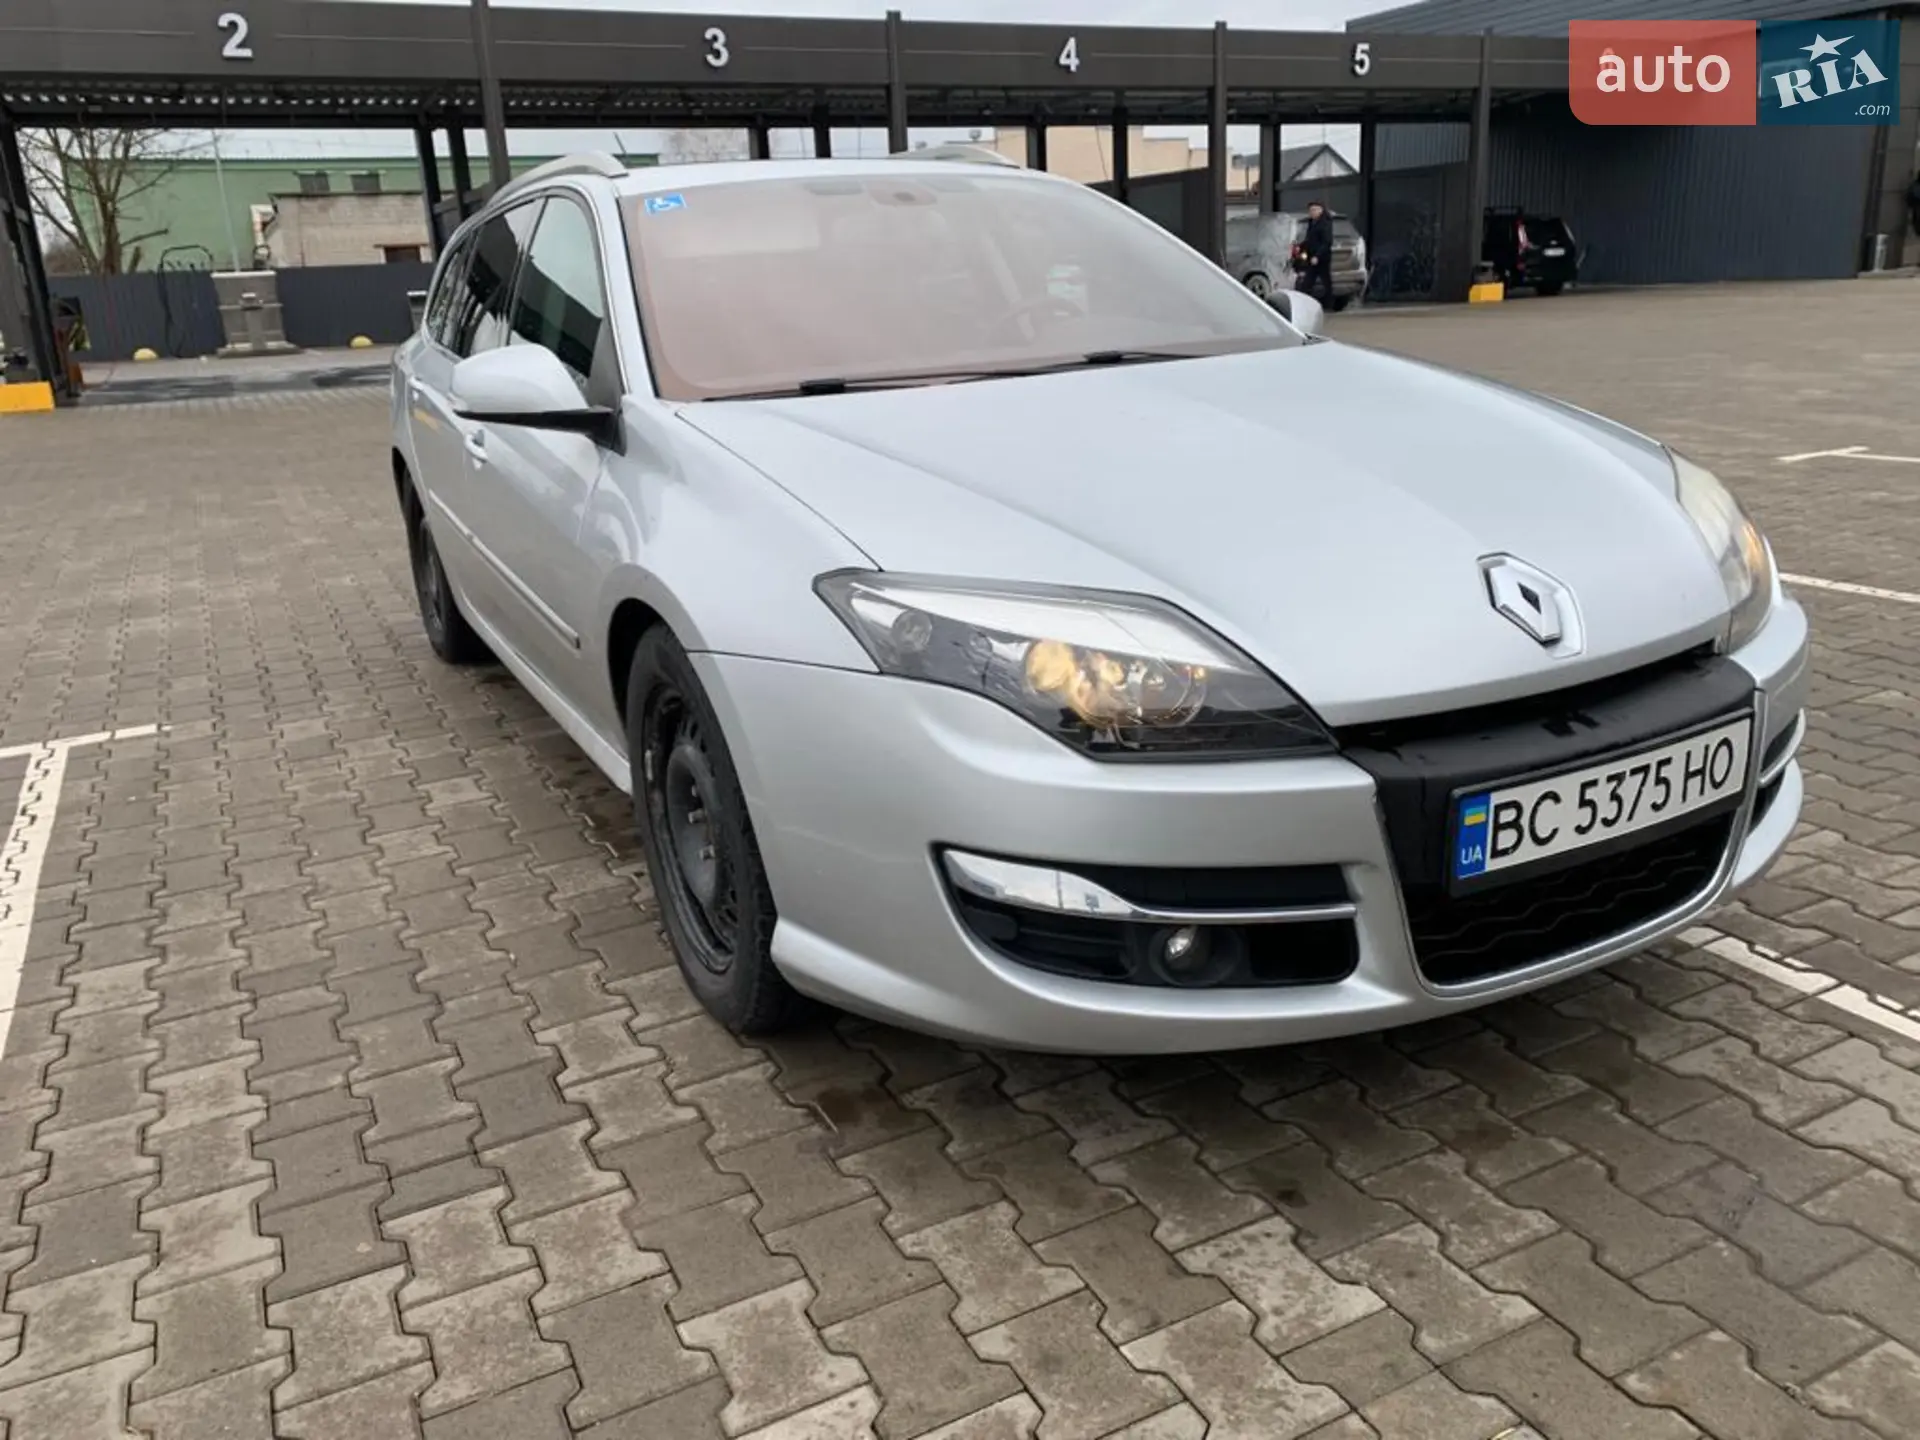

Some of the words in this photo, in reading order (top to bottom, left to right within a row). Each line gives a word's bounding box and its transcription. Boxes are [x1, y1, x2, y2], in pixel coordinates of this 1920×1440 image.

[217, 12, 254, 59] 2
[704, 28, 730, 69] 3
[1058, 37, 1080, 73] 4
[1352, 43, 1371, 76] 5
[1490, 790, 1562, 860] BC
[1575, 757, 1673, 836] 5375
[1682, 737, 1735, 803] HO
[1460, 844, 1484, 865] UA
